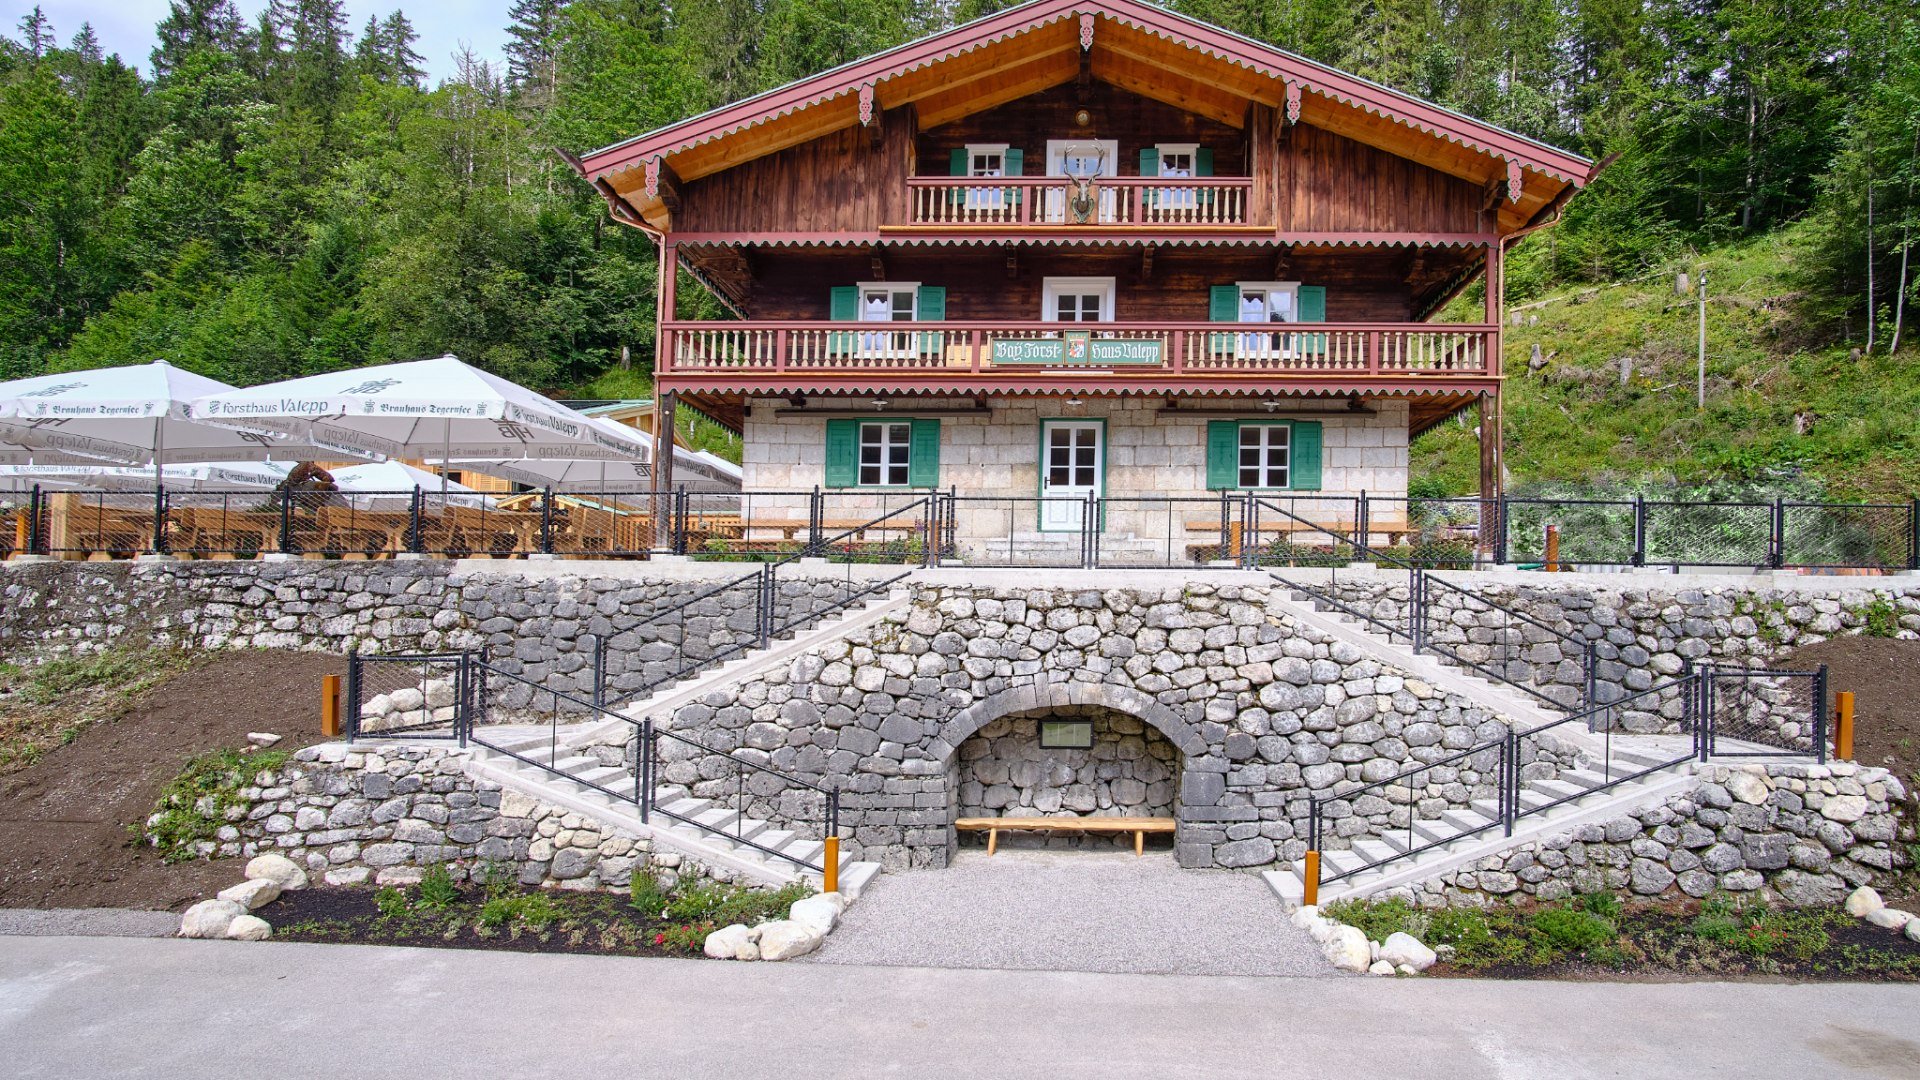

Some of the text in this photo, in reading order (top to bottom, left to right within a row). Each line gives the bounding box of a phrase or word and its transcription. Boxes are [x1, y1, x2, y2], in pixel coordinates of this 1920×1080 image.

[1092, 342, 1158, 363] Haus Valepp
[52, 405, 140, 416] Brauhaus Tegernsee
[281, 398, 329, 414] Valepp
[380, 403, 472, 415] Brauhaus Tegernsee
[549, 415, 579, 437] Valepp
